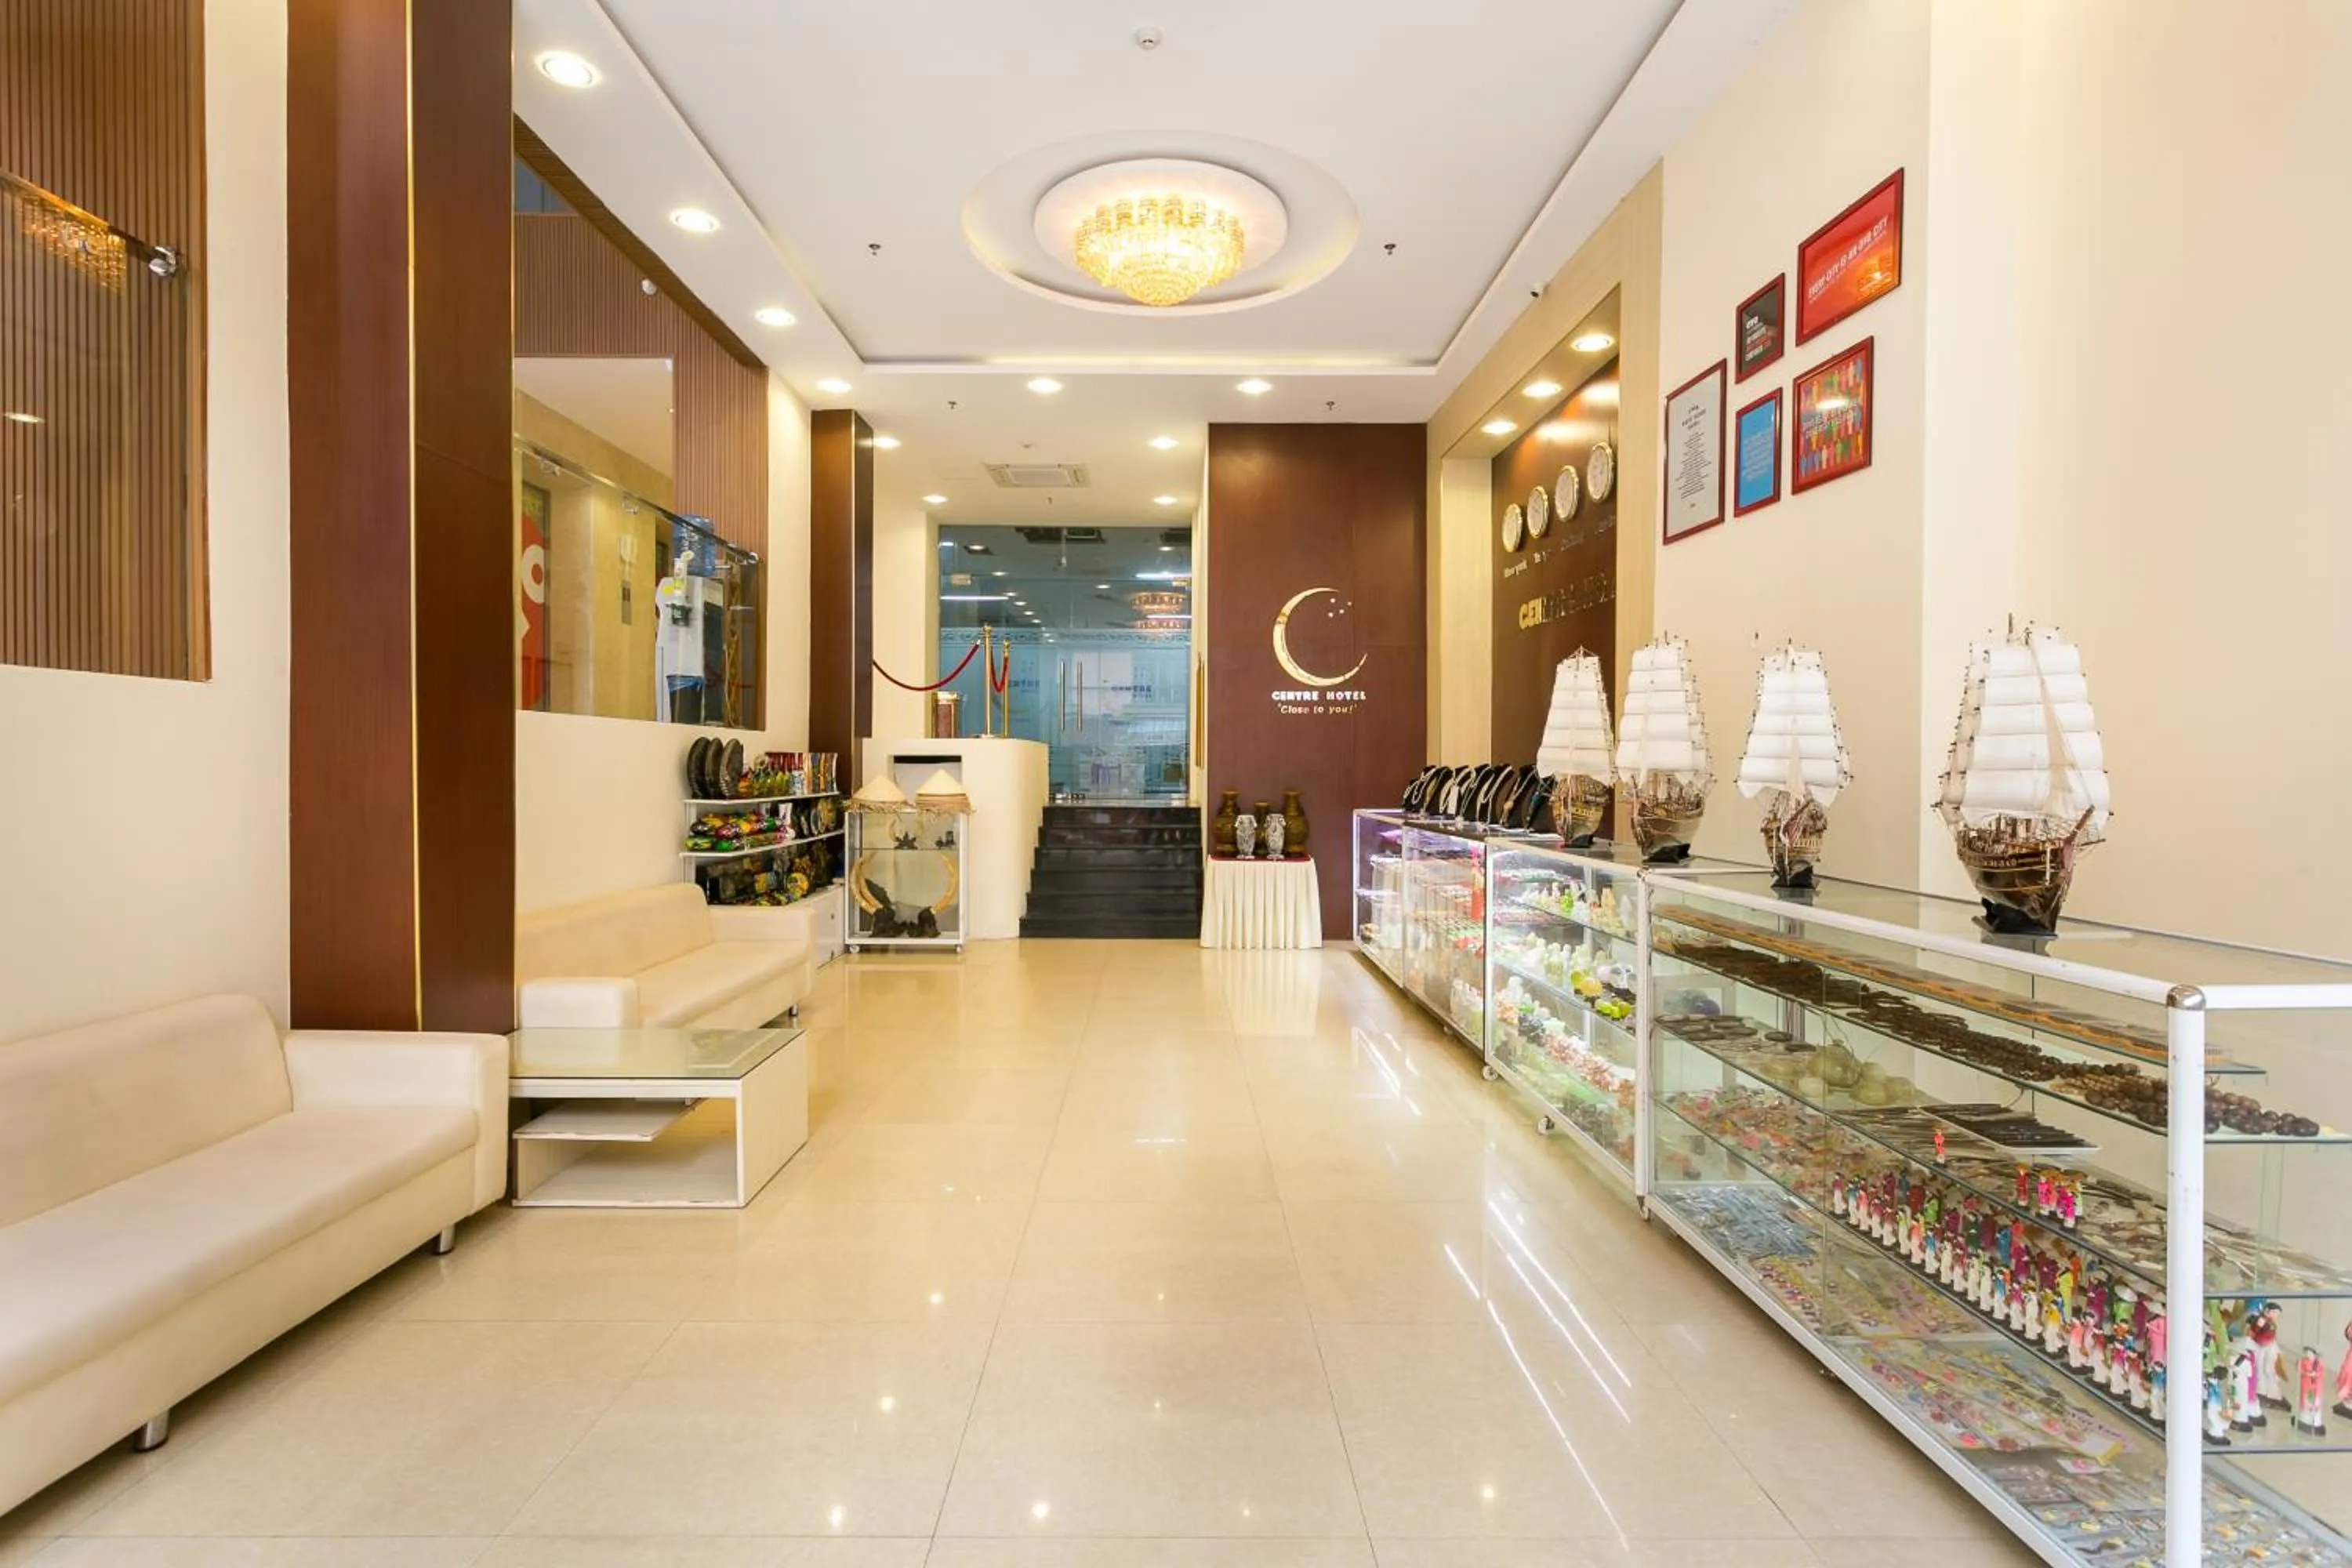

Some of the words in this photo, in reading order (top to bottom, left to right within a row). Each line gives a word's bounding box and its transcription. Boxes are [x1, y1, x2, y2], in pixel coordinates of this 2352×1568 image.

[1271, 691, 1319, 701] CENTRE
[1326, 691, 1367, 701] HOTEL
[1313, 706, 1324, 714] to
